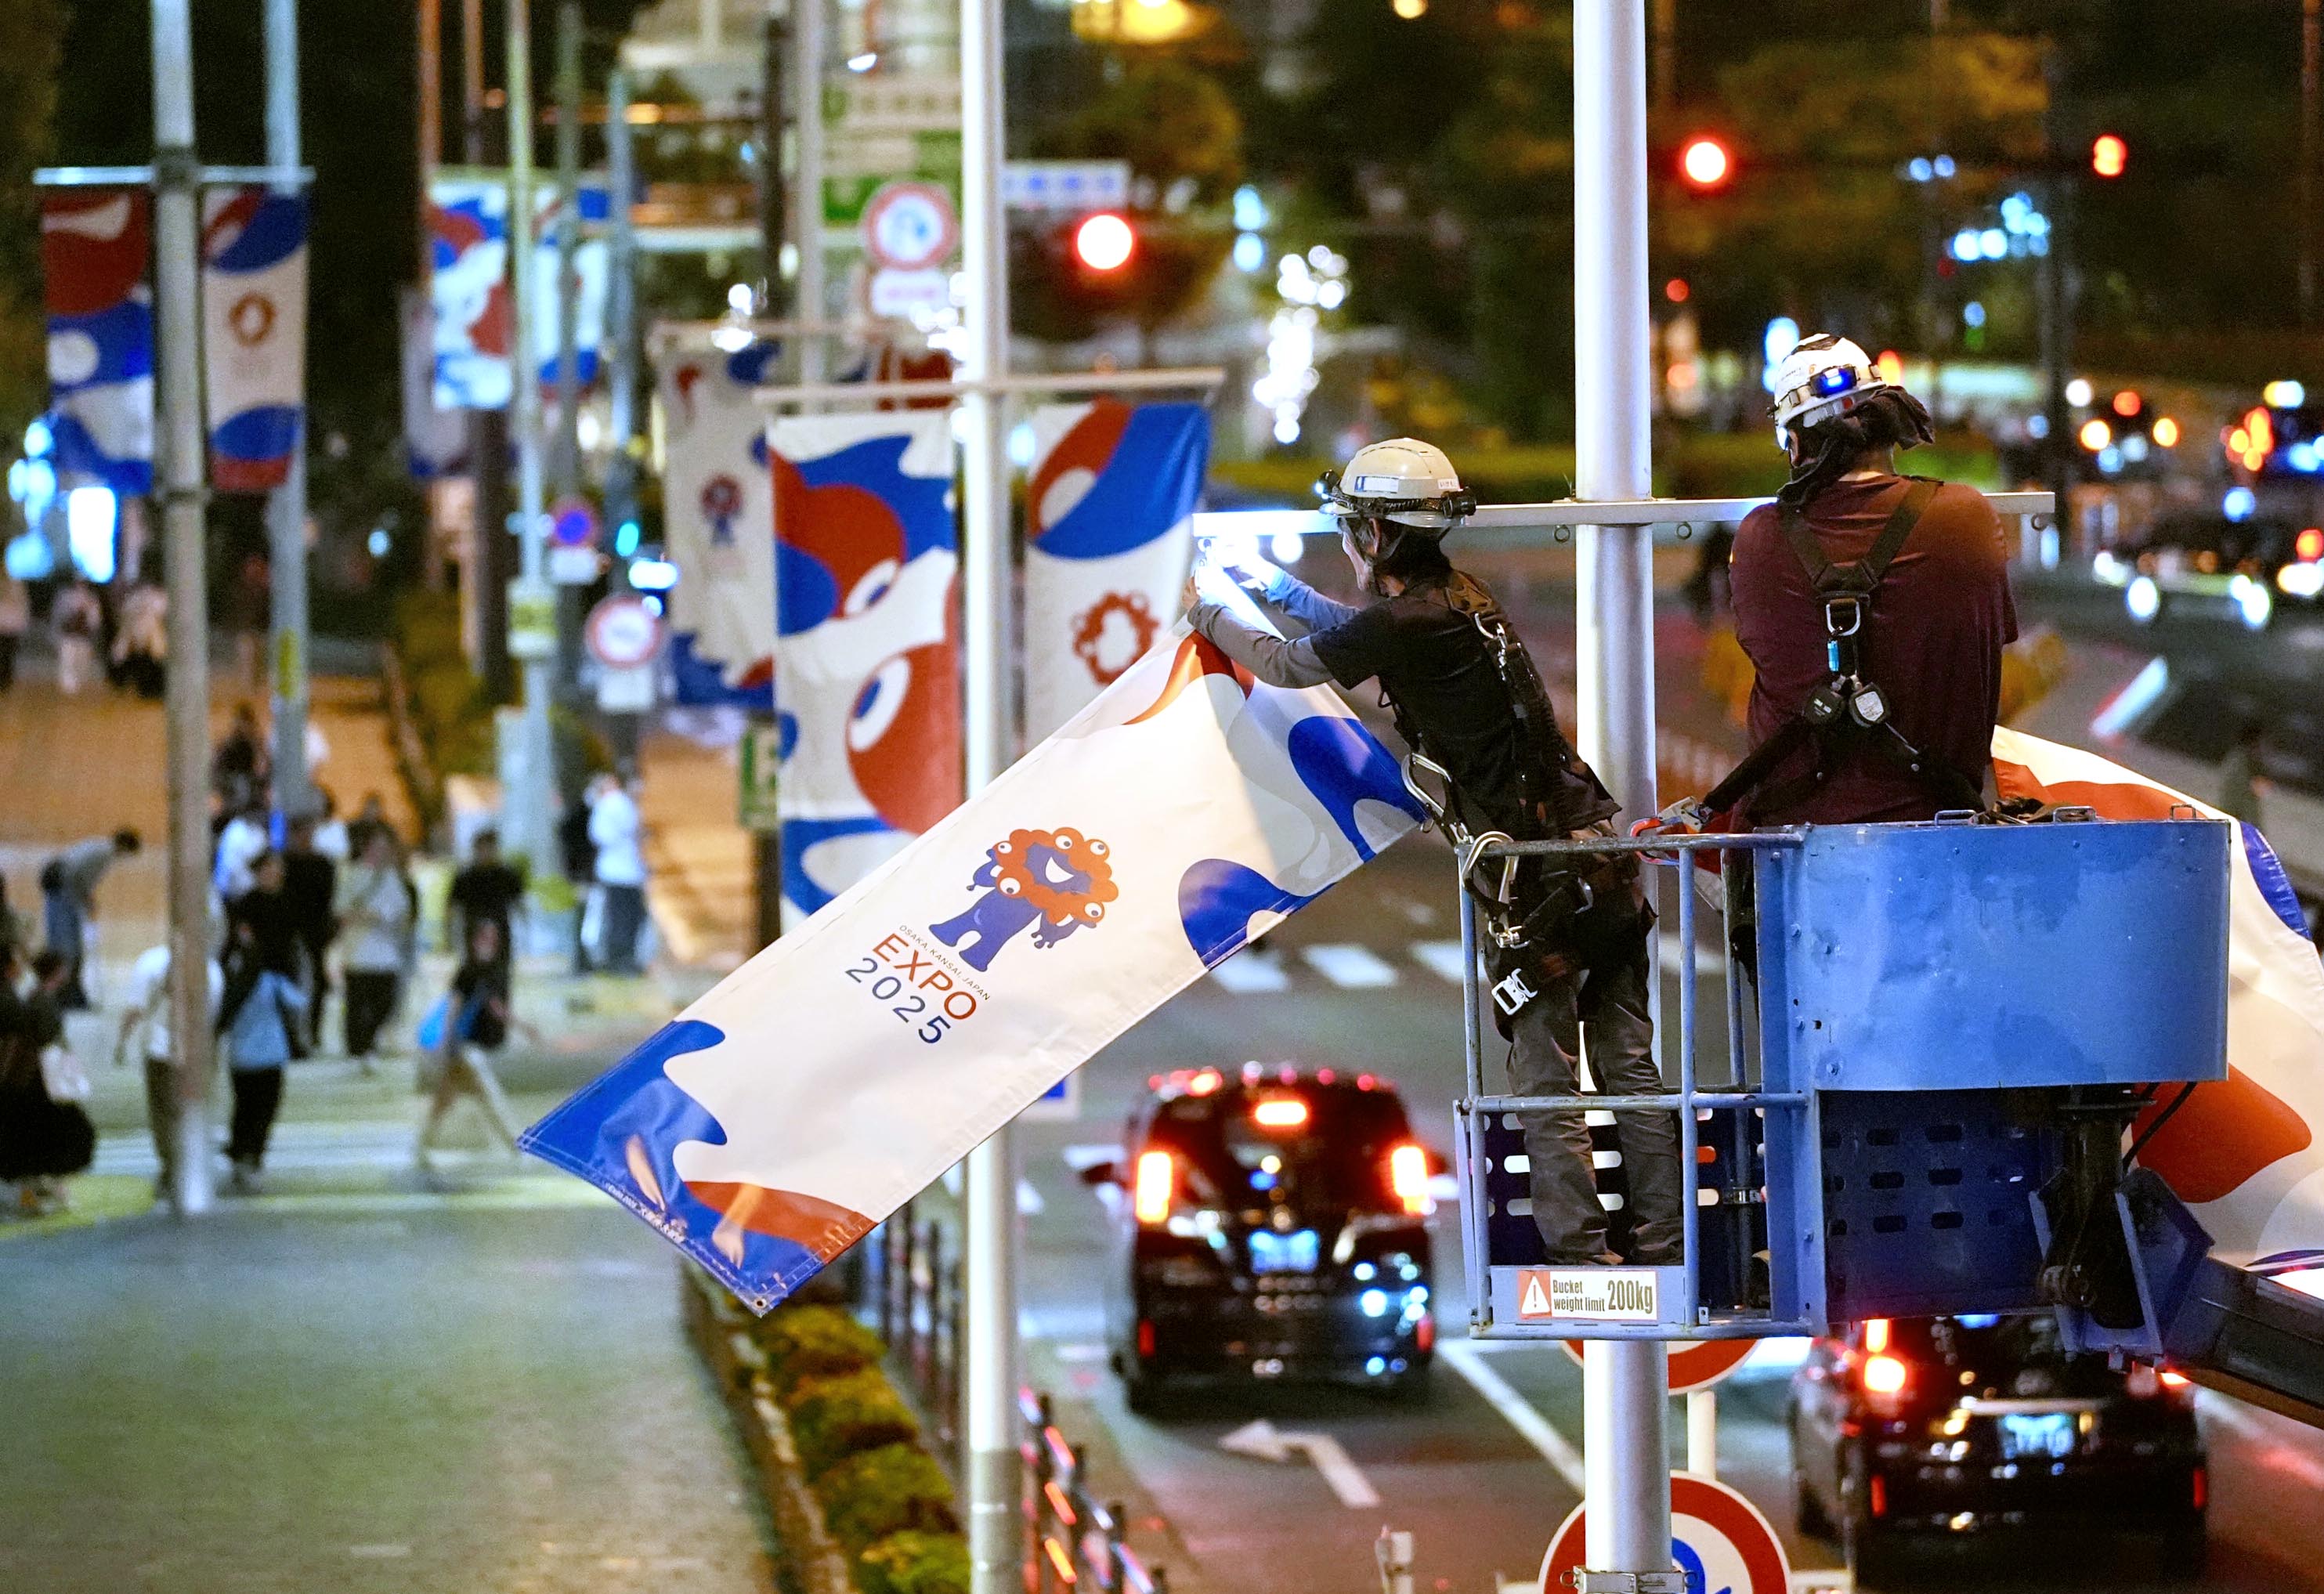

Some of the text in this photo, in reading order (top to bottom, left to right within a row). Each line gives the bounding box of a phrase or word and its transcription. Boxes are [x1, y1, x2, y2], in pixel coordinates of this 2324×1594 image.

[873, 933, 977, 1020] EXPO
[899, 925, 928, 951] OSAKA,
[962, 978, 990, 1000] JAPAN
[845, 957, 951, 1044] 2025
[1552, 1279, 1583, 1294] Bucket
[1553, 1297, 1606, 1312] weight limit
[1607, 1280, 1653, 1314] 200kg
